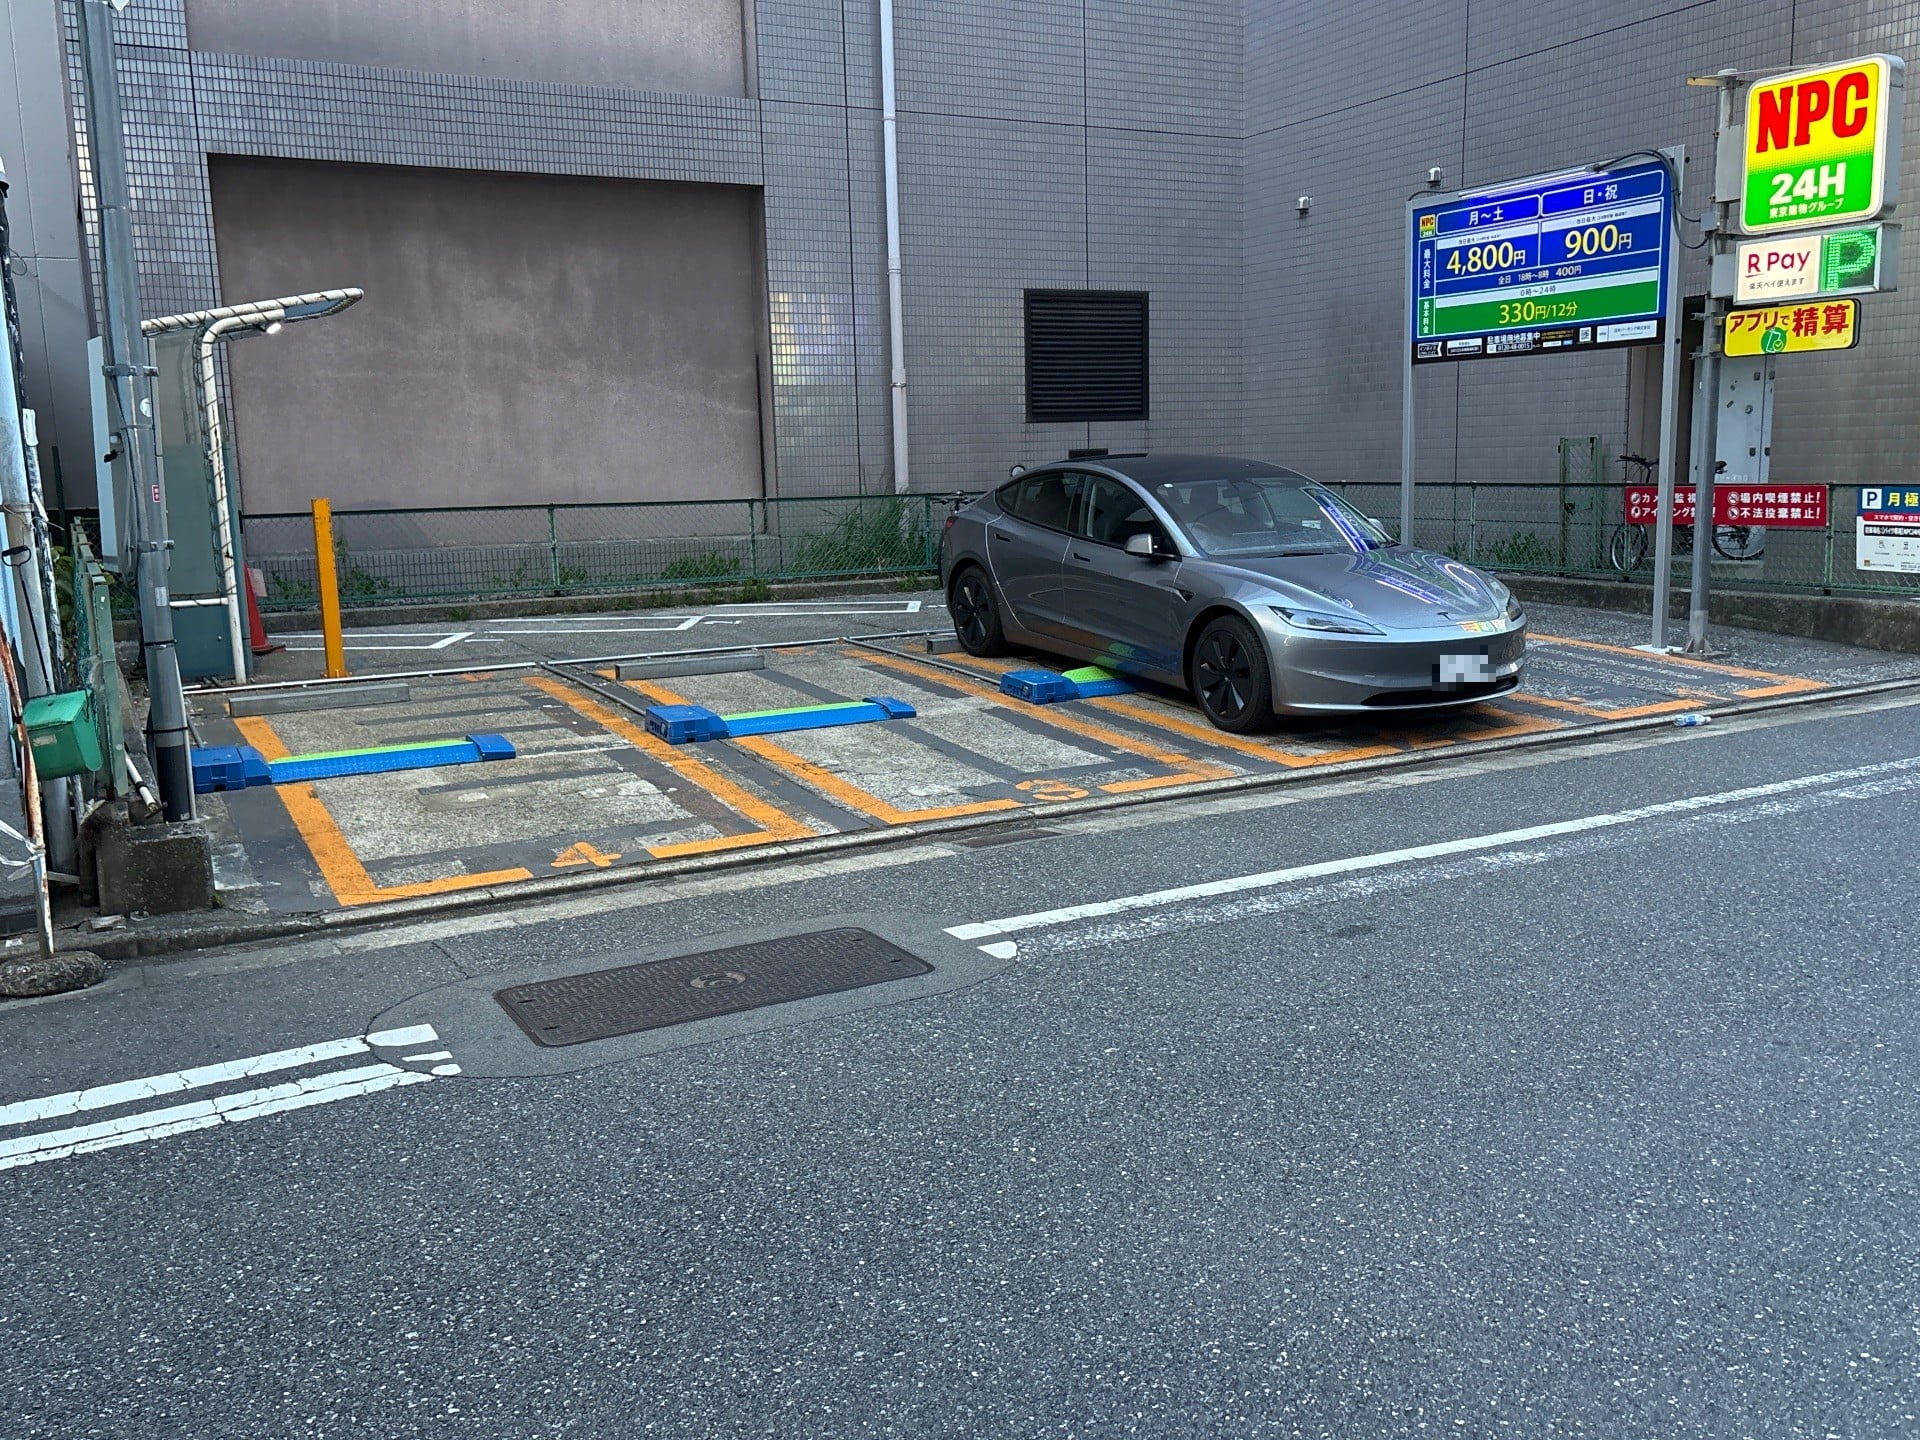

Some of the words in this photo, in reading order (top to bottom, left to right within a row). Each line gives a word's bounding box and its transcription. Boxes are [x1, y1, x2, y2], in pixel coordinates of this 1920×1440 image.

[1756, 72, 1869, 153] NPC
[1583, 184, 1618, 205] 日・祝
[1769, 162, 1847, 205] 24H
[1769, 198, 1844, 218] 東京建物グループ
[1421, 216, 1434, 227] NPC
[1565, 224, 1632, 258] 900円
[1423, 248, 1432, 289] 最大料金
[1446, 242, 1526, 275] 4,800円
[1767, 251, 1811, 272] Pay
[1827, 232, 1876, 291] P
[1498, 275, 1511, 285] 全日
[1556, 265, 1582, 277] 400円
[1749, 278, 1805, 290] 楽天ペイ使えます
[1498, 301, 1578, 324] 330円/12分
[1729, 304, 1851, 337] アプリで精算
[1740, 491, 1821, 504] 場内喫煙禁止!
[1867, 491, 1878, 506] P
[1015, 778, 1090, 801] 3
[550, 841, 622, 868] 4
